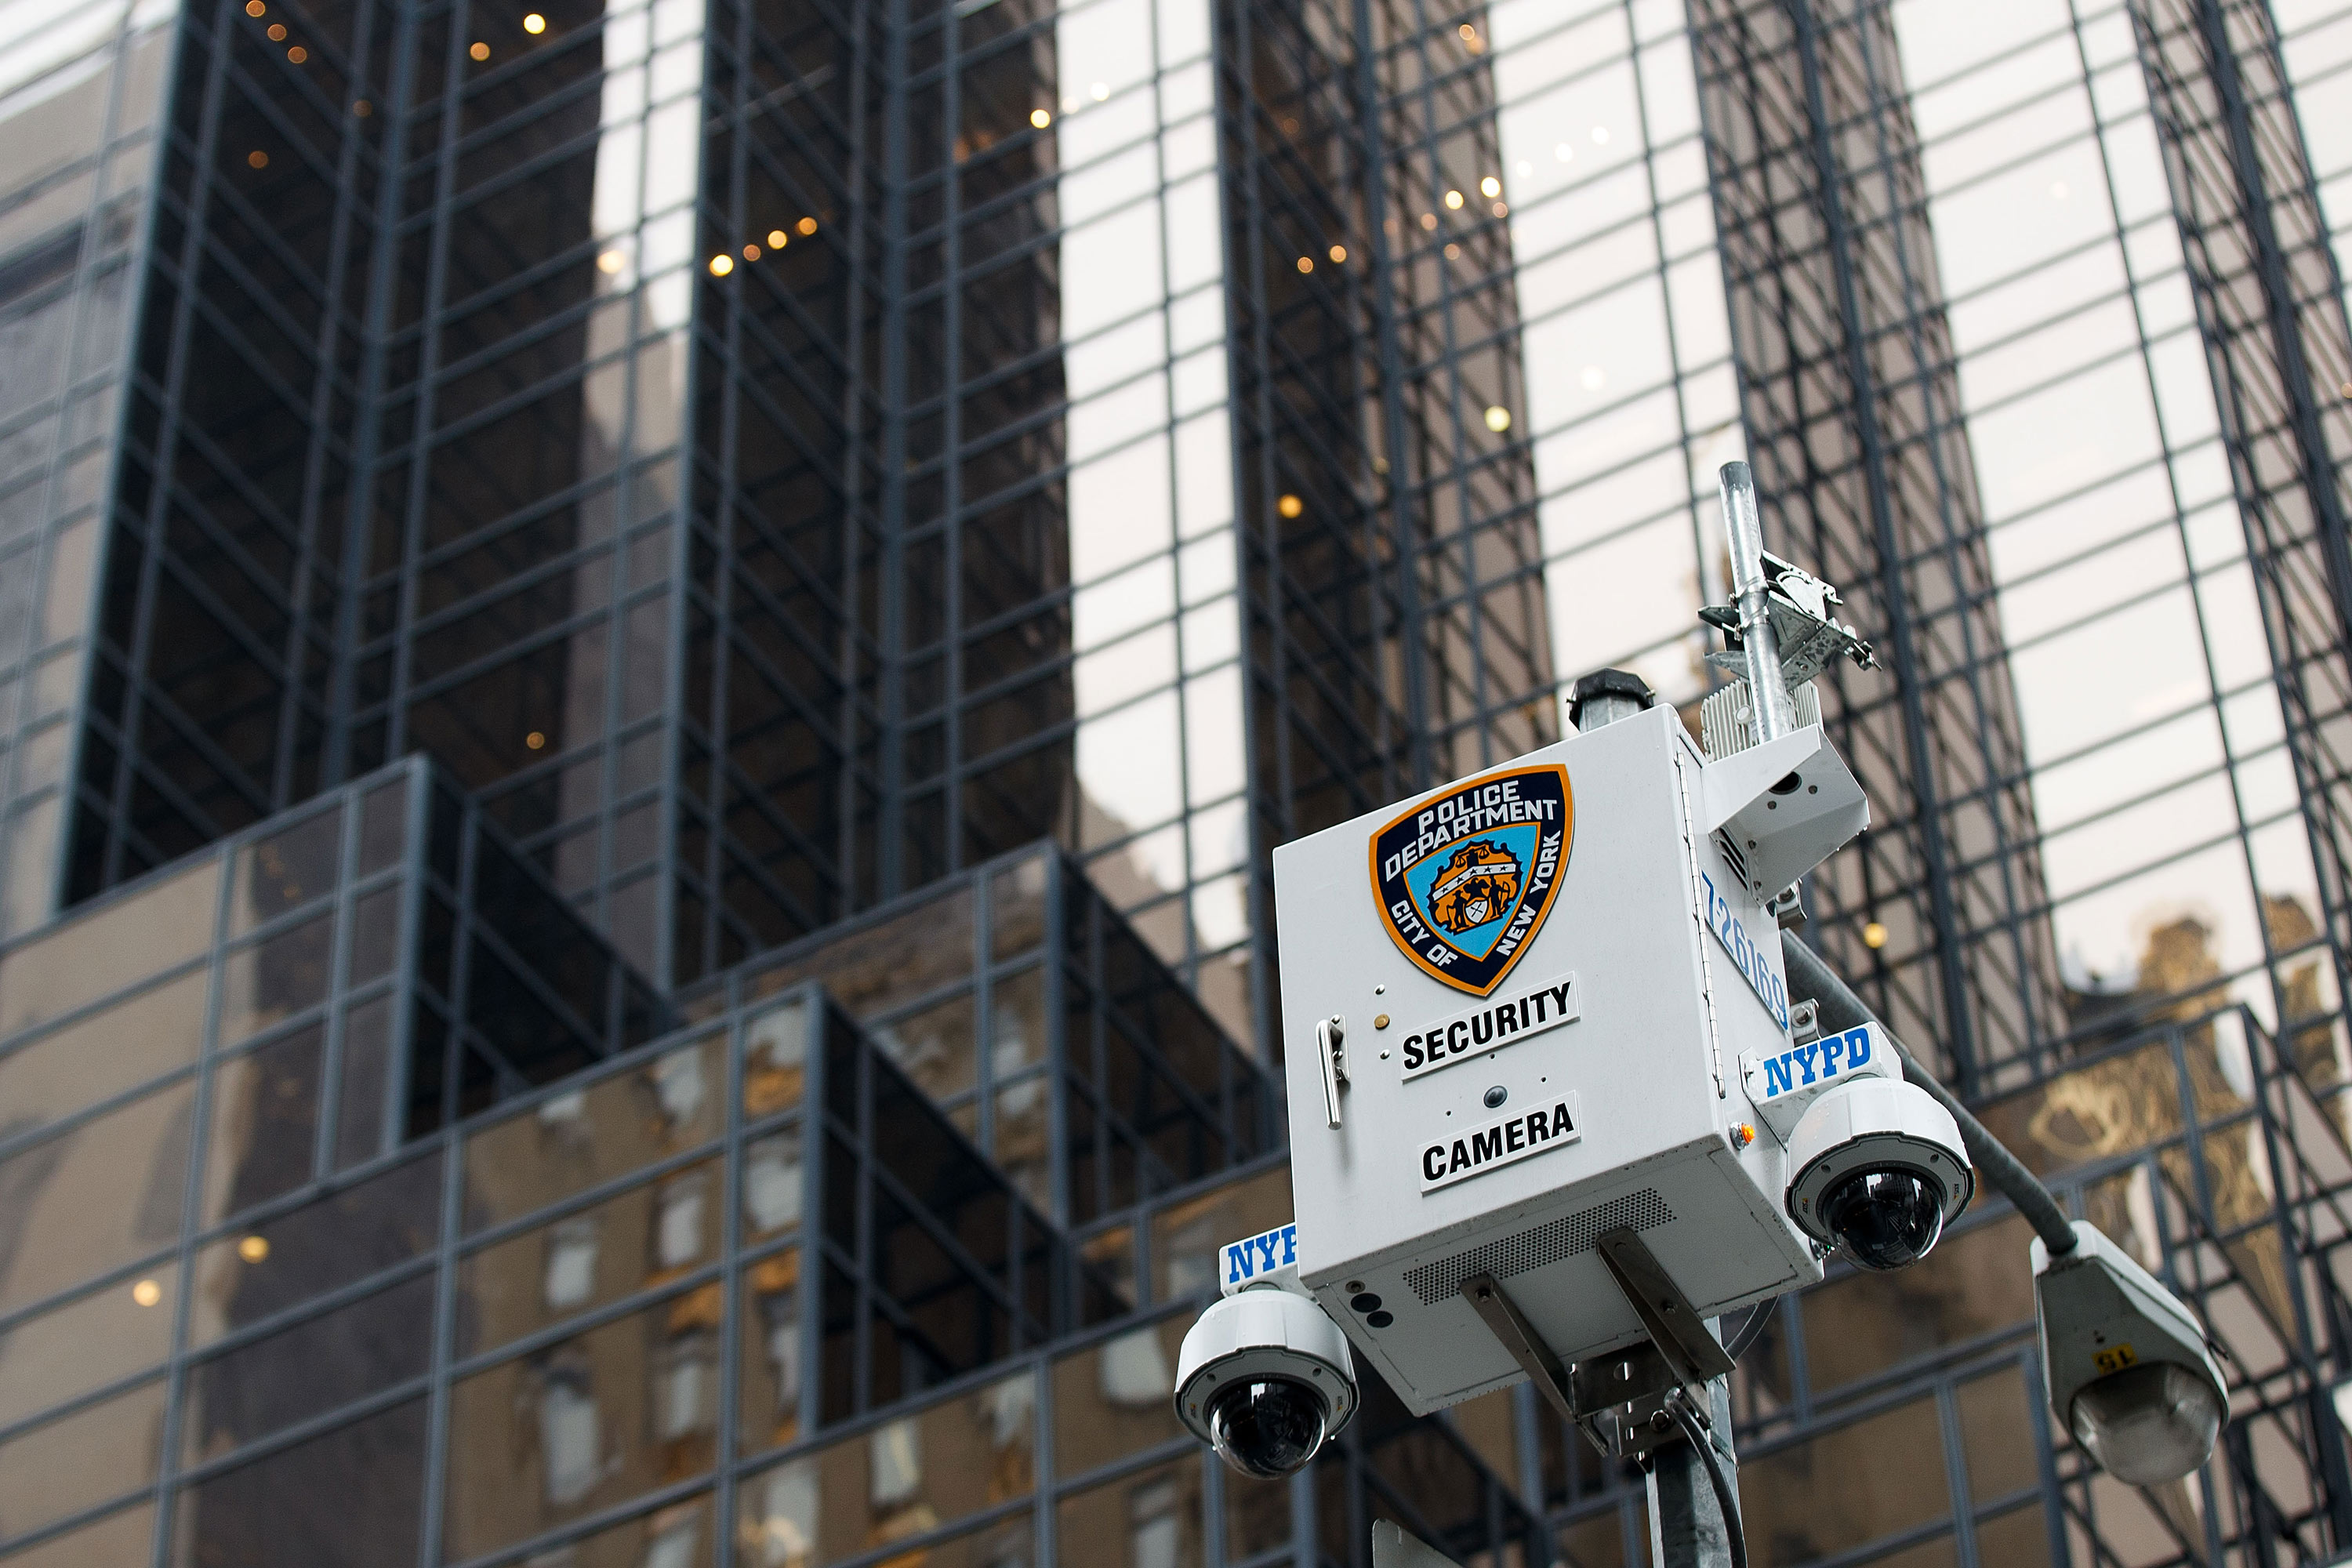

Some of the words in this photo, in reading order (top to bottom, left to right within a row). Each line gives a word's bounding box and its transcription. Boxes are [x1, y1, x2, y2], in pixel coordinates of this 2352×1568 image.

[1385, 799, 1558, 883] DEPARTMENT
[1418, 780, 1520, 836] POLICE
[1391, 900, 1430, 945] CITY
[1426, 943, 1458, 967] OF
[1496, 904, 1537, 956] NEW
[1530, 830, 1561, 894] YORK
[1701, 869, 1788, 1031] 7-26169
[1403, 981, 1571, 1070] SECURITY
[1763, 1027, 1871, 1098] NYPD
[1422, 1102, 1574, 1181] CAMERA
